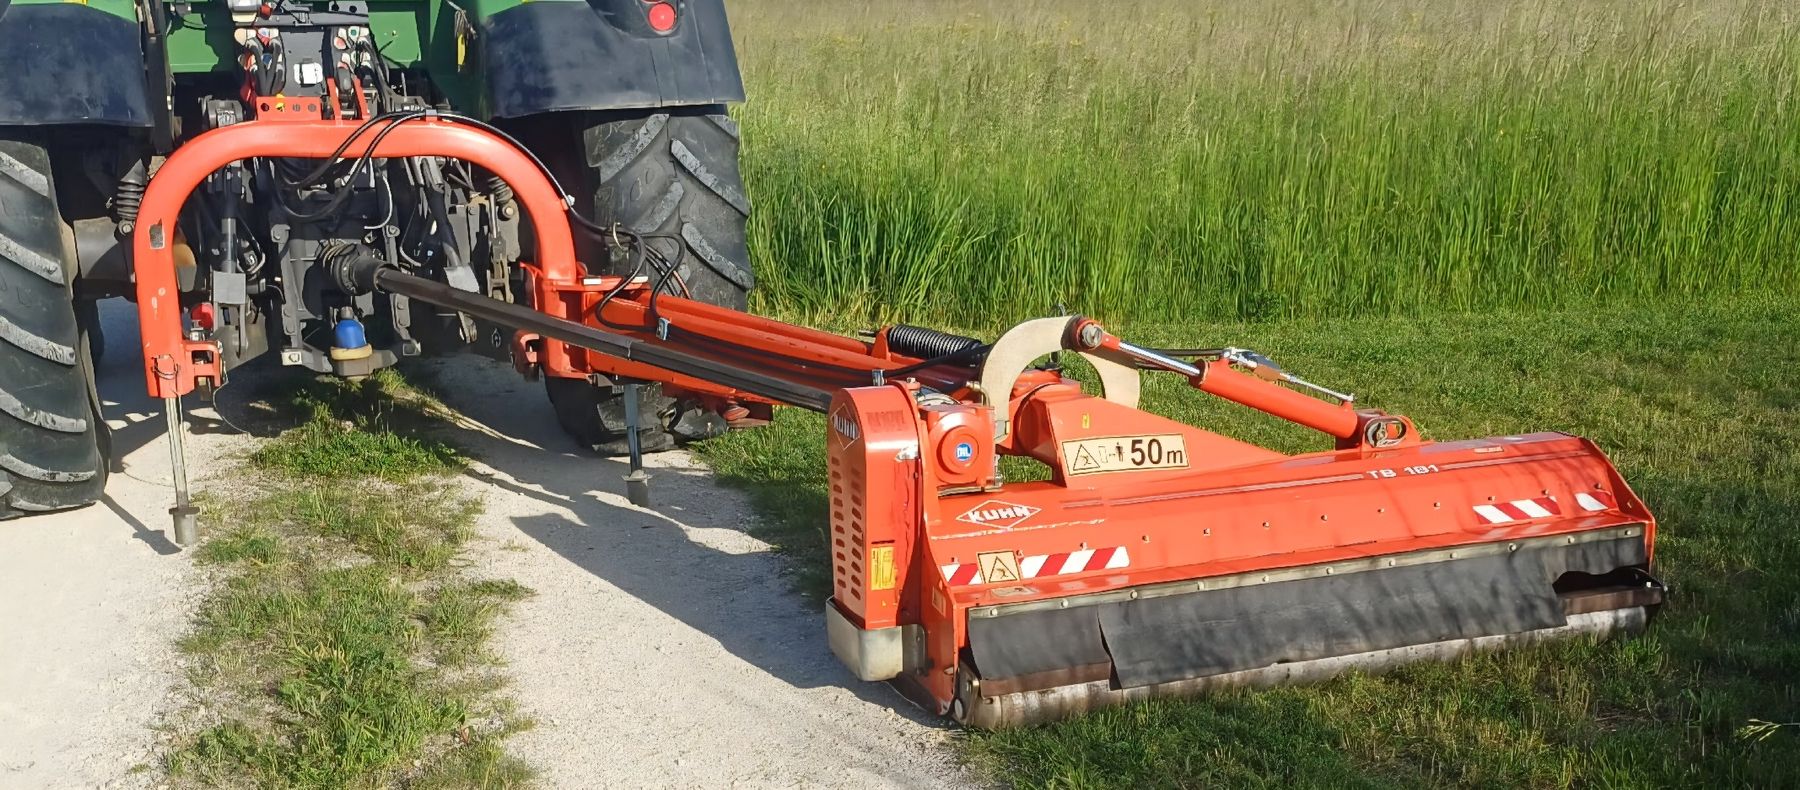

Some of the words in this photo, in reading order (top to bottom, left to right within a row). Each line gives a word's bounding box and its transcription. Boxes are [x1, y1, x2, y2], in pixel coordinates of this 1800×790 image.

[1366, 469, 1397, 479] TB
[1403, 464, 1439, 475] 181
[967, 505, 1031, 523] KUHN
